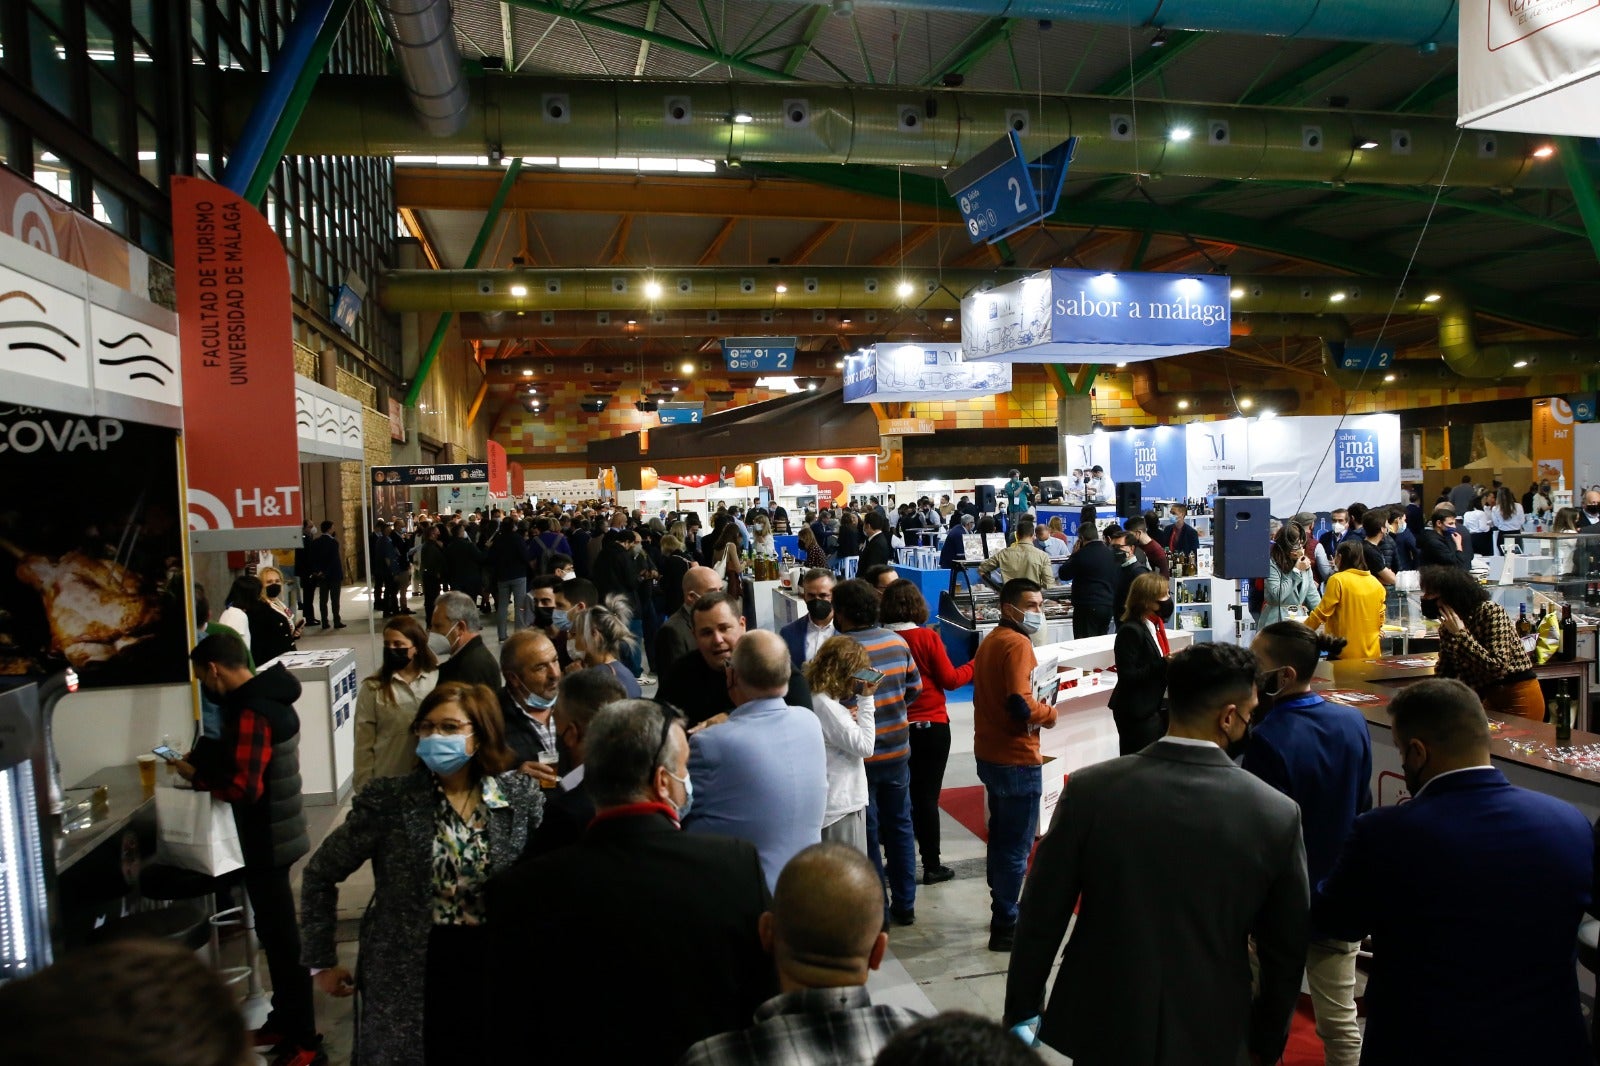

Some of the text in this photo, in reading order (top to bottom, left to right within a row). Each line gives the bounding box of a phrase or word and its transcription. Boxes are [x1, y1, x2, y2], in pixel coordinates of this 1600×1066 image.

[1007, 177, 1028, 213] 2
[196, 201, 221, 368] FACULTAD DE TURISMO
[219, 202, 248, 386] UNIVERSIDAD DE MÁLAGA
[1056, 291, 1226, 327] sabor a málaga
[763, 349, 769, 358] 1
[777, 352, 788, 368] 2
[1378, 352, 1388, 367] 2
[690, 411, 698, 422] 2
[0, 419, 124, 453] OVAP
[1345, 434, 1375, 455] má
[417, 467, 435, 475] GUSTO
[1135, 457, 1157, 482] laga
[1339, 450, 1375, 473] laga
[430, 473, 454, 482] NUESTRO
[235, 486, 300, 518] H&T
